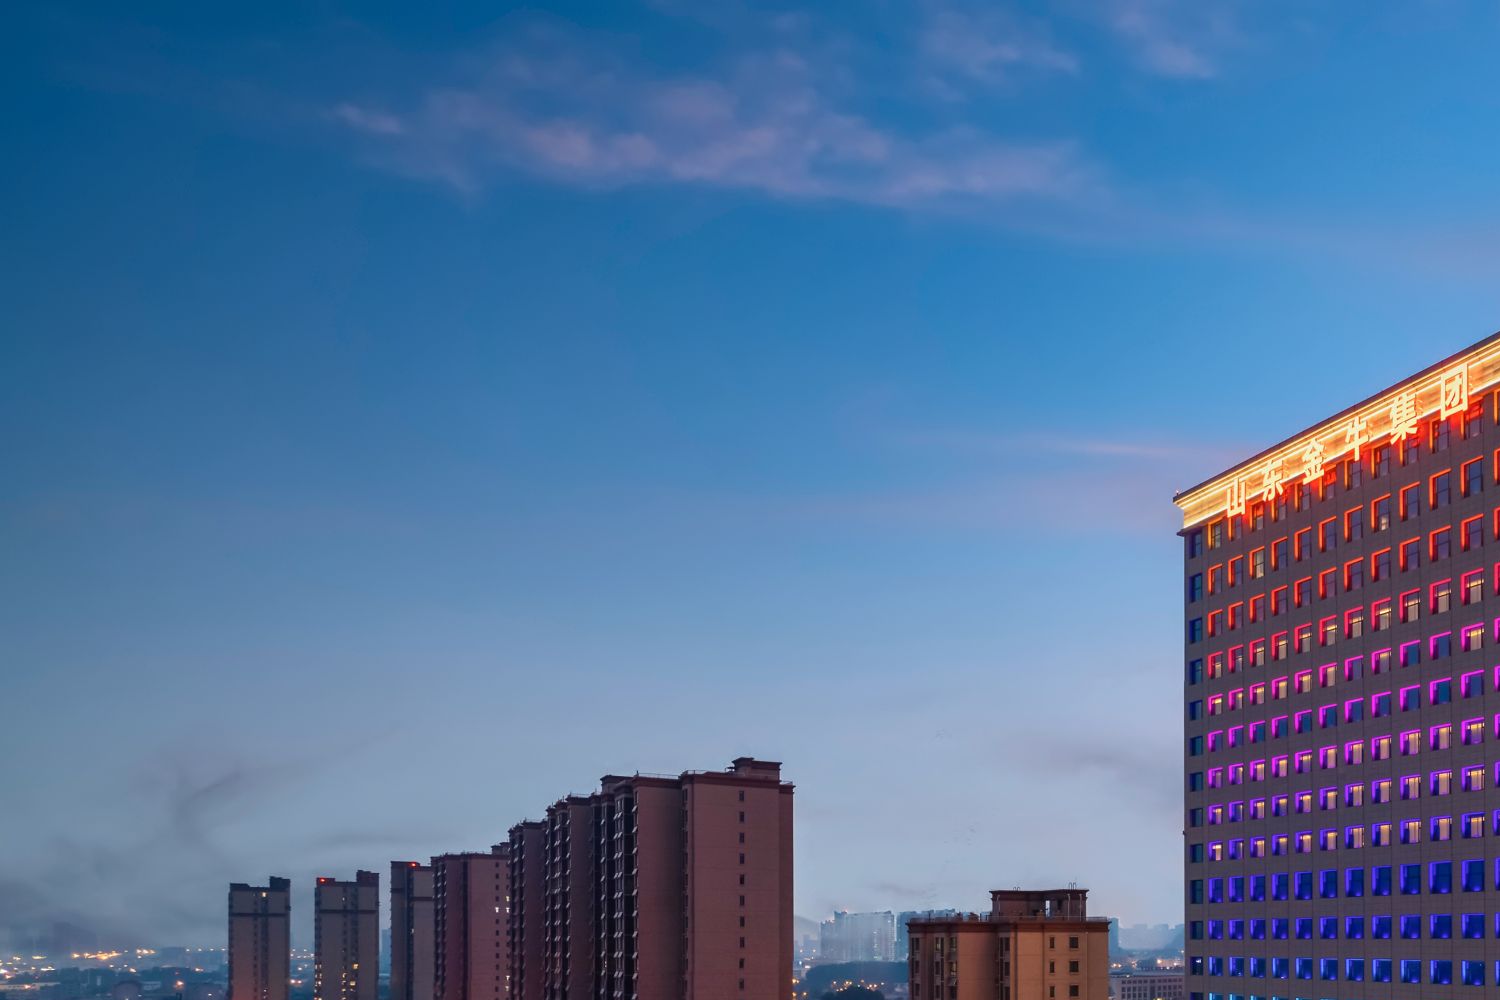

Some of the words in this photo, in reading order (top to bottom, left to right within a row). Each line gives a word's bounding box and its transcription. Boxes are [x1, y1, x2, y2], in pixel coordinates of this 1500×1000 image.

[1227, 364, 1468, 517] 山东金牛集团
